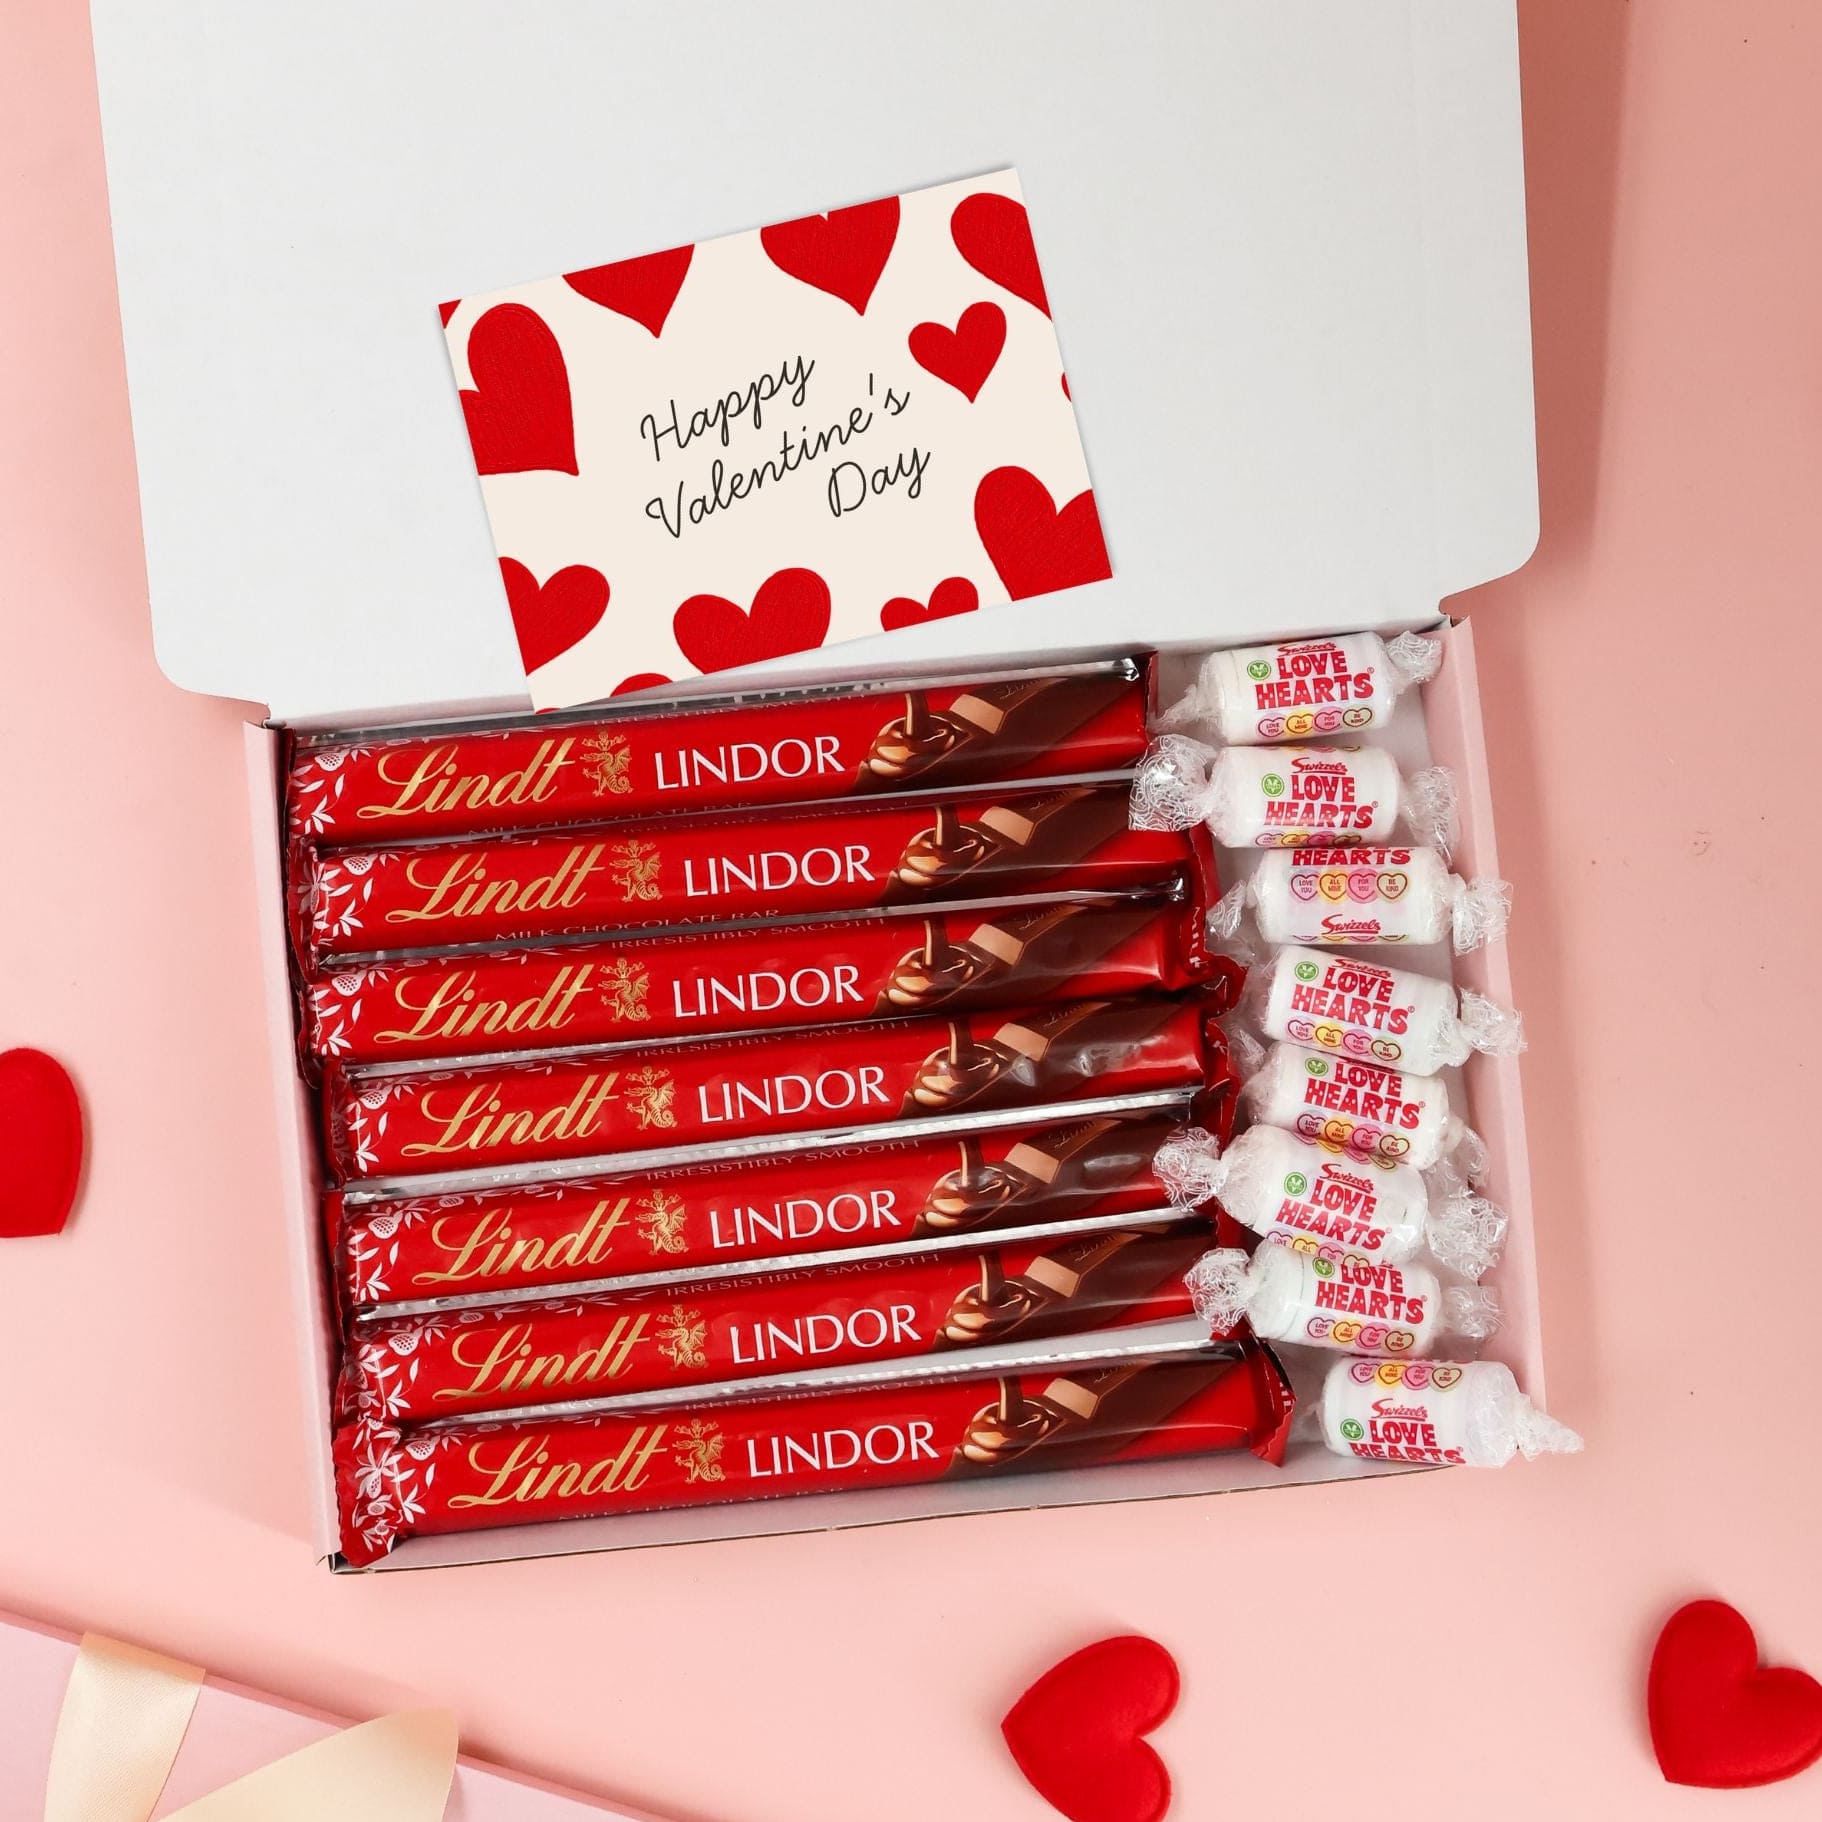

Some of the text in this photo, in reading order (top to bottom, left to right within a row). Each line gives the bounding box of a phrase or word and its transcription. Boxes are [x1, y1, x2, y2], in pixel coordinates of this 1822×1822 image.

[640, 355, 815, 462] Happy
[645, 372, 911, 538] Valentine's
[828, 447, 931, 517] Day
[1276, 651, 1348, 680] LOVE
[1254, 672, 1374, 710] HEARTS
[357, 736, 845, 819] Lindt LINDOR
[1290, 774, 1355, 802] LOVE
[1263, 801, 1373, 829] HEARTS
[1291, 848, 1411, 866] HEARTS
[385, 842, 875, 923] Lindt LINDOR
[495, 927, 556, 941] MILK
[731, 908, 780, 921] BAR
[1321, 914, 1381, 935] Swizzels
[373, 963, 864, 1043] Lindt LINDOR
[1322, 967, 1395, 1003] LOVE
[1291, 984, 1409, 1035] HEARTS
[1334, 1062, 1403, 1098] LOVE
[400, 1066, 890, 1157] Lindt LINDOR
[1304, 1078, 1420, 1130] HEARTS
[646, 1139, 920, 1181] IRRESISTIBLY SMOOTH
[1309, 1178, 1377, 1222] LOVE
[411, 1190, 902, 1286] Lindt LINDOR
[1274, 1238, 1288, 1247] LOVE
[1275, 1198, 1387, 1250] HEARTS
[666, 1253, 940, 1297] IRRESISTIBLY SMOOTH
[1340, 1263, 1404, 1294] LOVE
[1315, 1281, 1424, 1325] HEARTS
[431, 1304, 922, 1401] Lindt LINDOR
[1349, 1442, 1467, 1465] HEARTS
[1369, 1419, 1437, 1447] LOVE
[447, 1424, 668, 1509] Lindt
[747, 1422, 939, 1478] LINDOR
